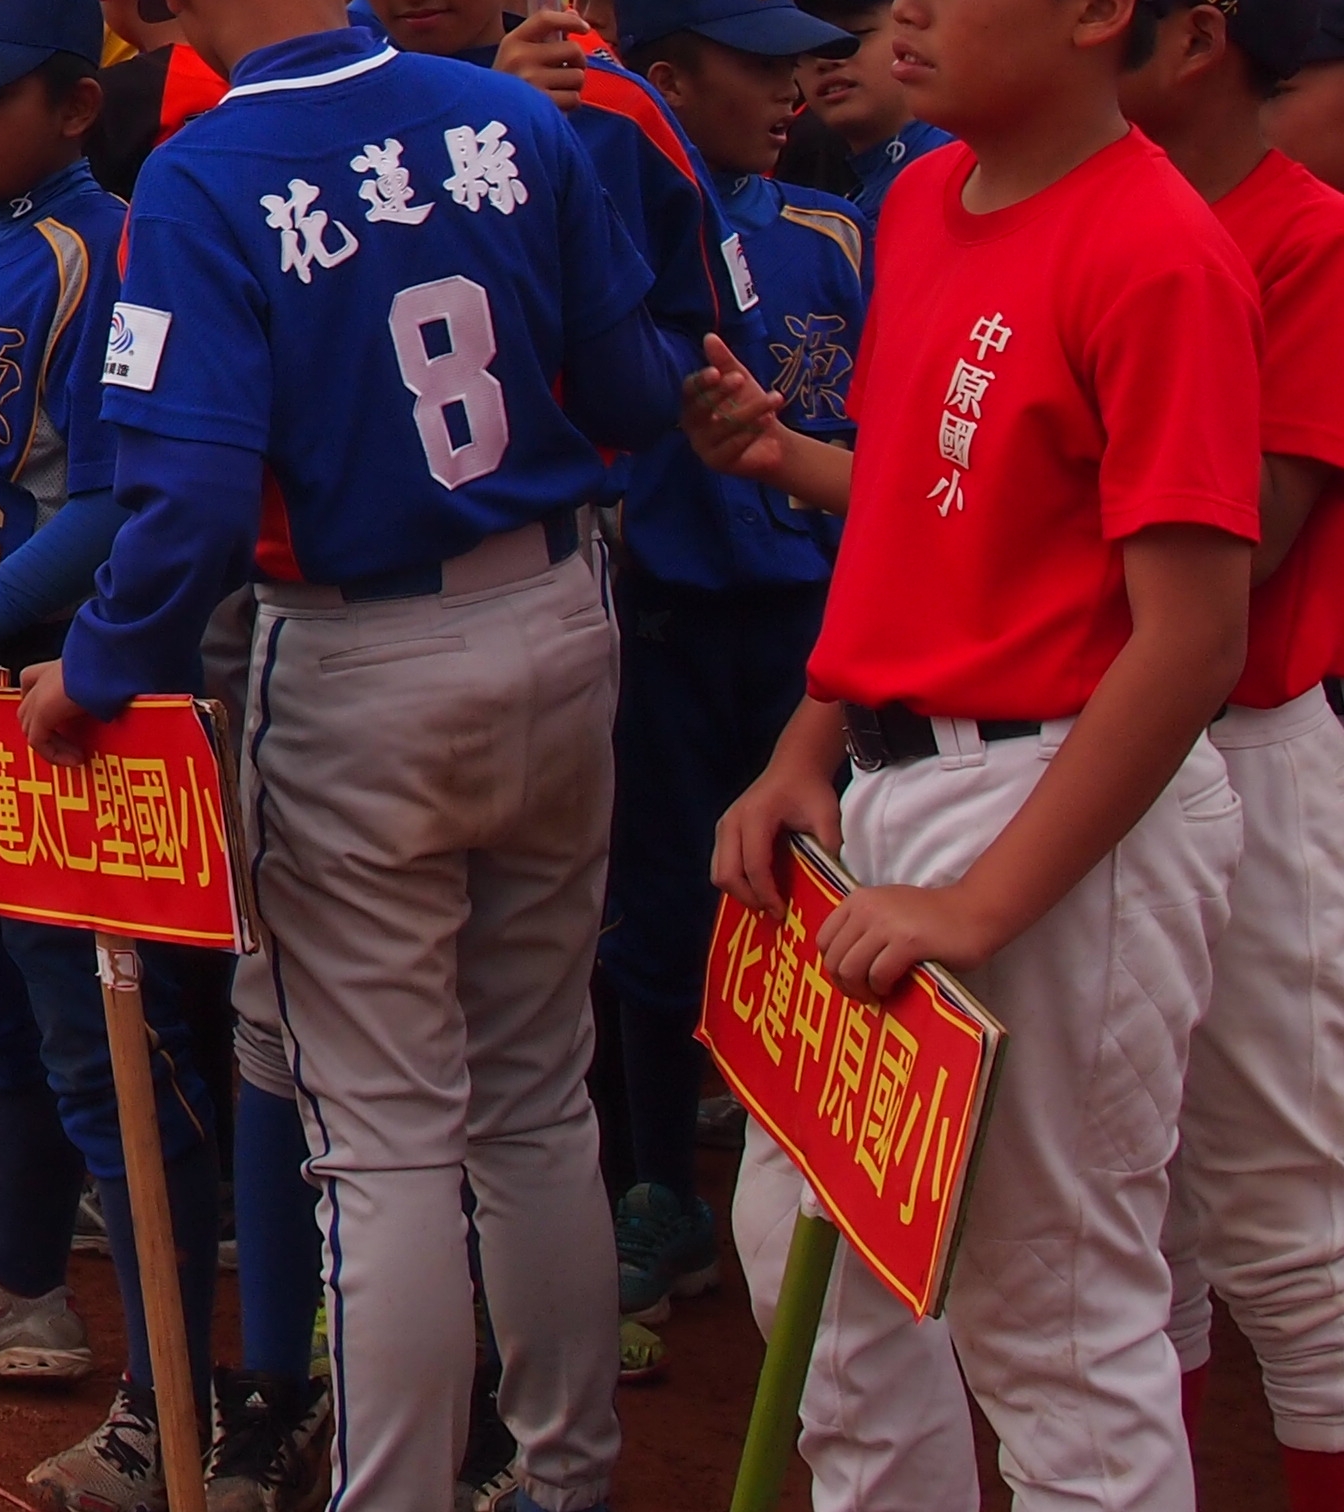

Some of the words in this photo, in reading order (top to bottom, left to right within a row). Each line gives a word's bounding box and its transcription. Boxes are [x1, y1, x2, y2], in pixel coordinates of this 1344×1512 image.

[260, 121, 530, 285] 花蓮縣
[388, 274, 510, 491] 8
[926, 311, 1013, 519] 中原國小
